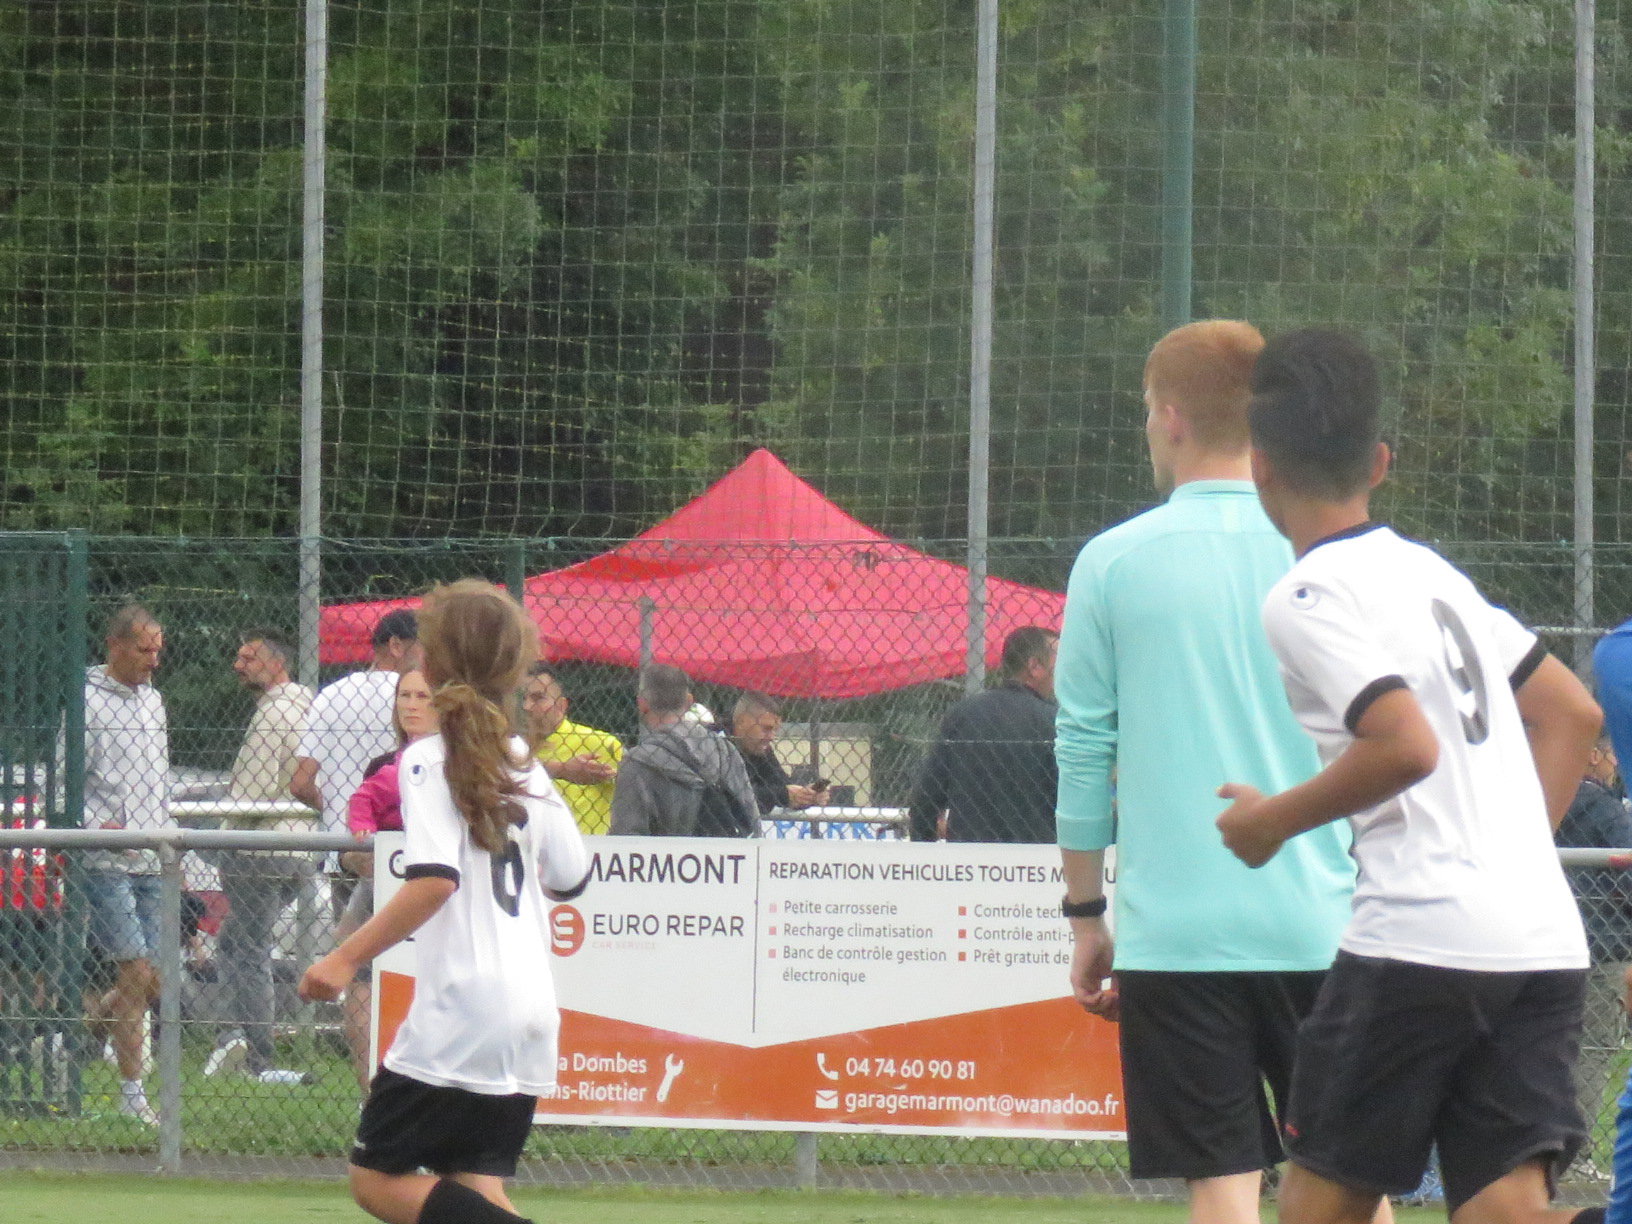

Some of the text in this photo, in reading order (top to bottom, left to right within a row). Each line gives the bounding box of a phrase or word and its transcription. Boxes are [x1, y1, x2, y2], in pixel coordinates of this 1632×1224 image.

[769, 862, 874, 880] REPARATION
[879, 864, 974, 882] VEHICULES
[978, 865, 1046, 882] TOUTES
[784, 901, 897, 915] Petite carrosserie
[974, 904, 1032, 918] Contrôle
[593, 913, 744, 937] EURO REPAR
[783, 923, 933, 940] Recharge climatisation
[974, 927, 1032, 941] Contrôle
[783, 945, 947, 964] Banc de contrôle gestion
[974, 949, 1070, 967] Prêt gratuit de
[783, 967, 866, 985] électronique
[573, 1052, 647, 1073] Dombes
[846, 1058, 976, 1079] 04 74 60 90 81
[845, 1092, 1119, 1116] garagemarmont@wanadoo.fr
